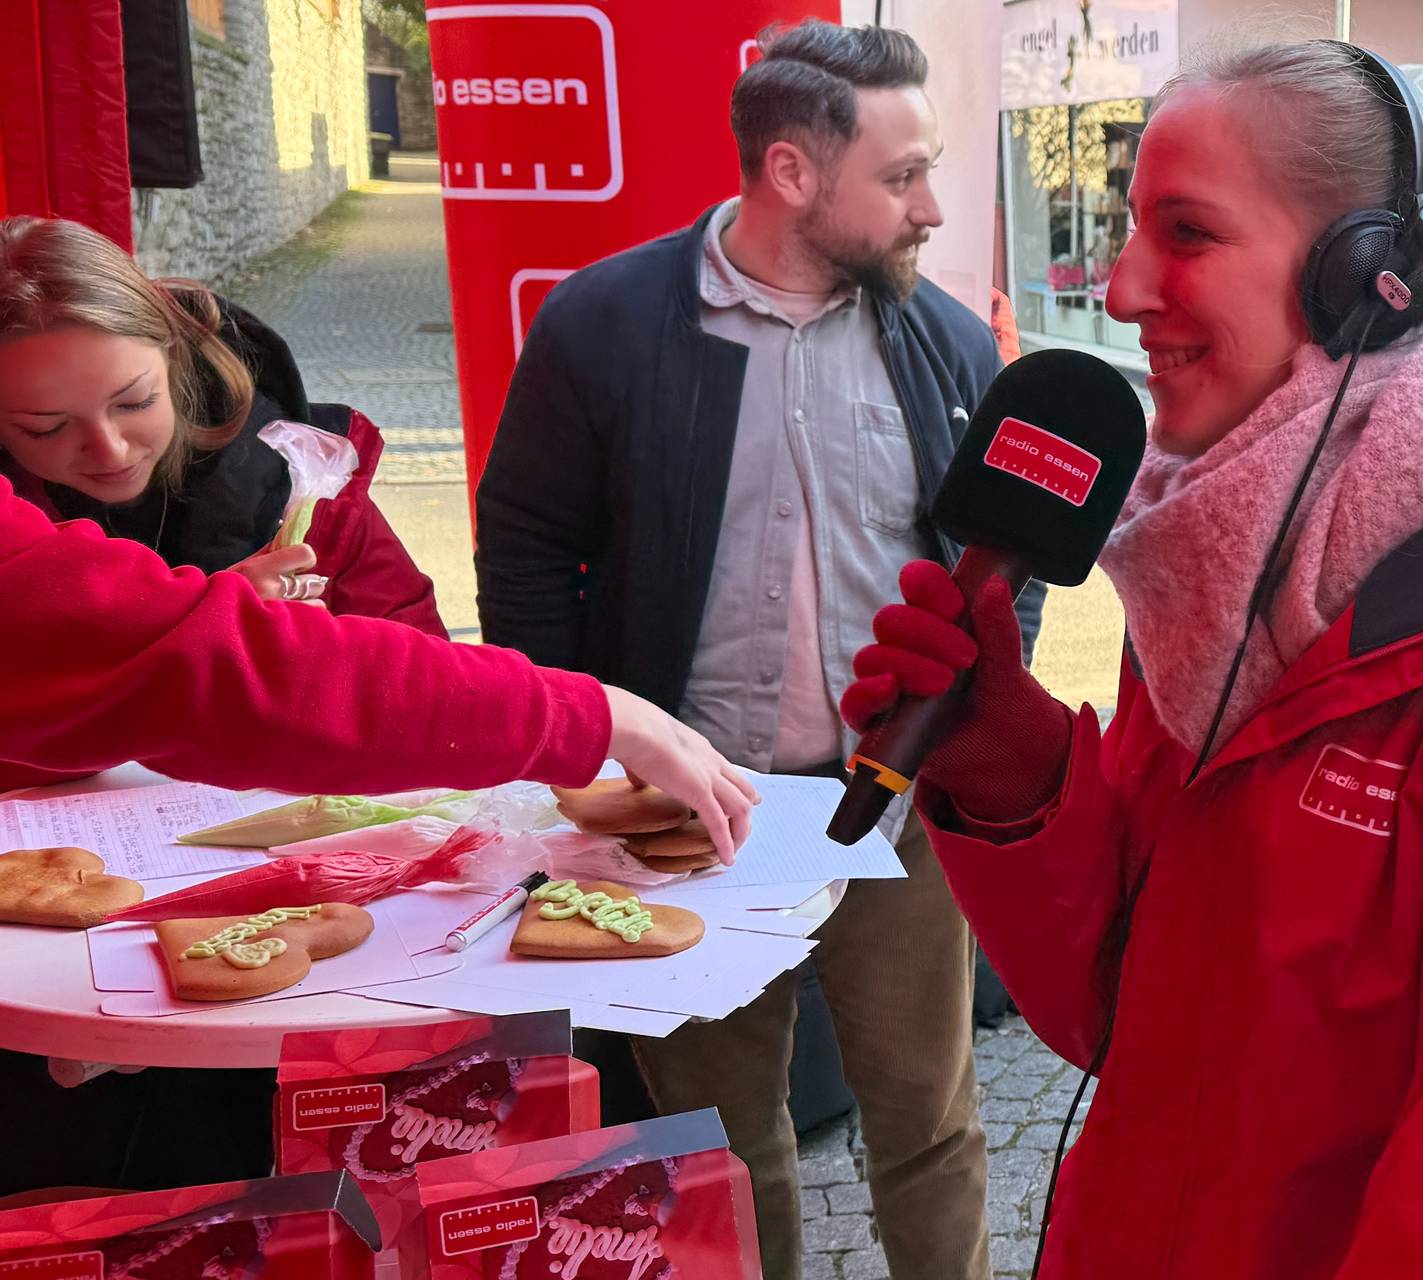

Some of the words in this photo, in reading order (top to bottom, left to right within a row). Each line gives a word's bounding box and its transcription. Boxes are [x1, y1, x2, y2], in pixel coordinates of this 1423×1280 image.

[452, 77, 588, 106] essen
[1000, 435, 1040, 456] radio
[1044, 453, 1089, 482] essen
[1318, 768, 1360, 791] radio
[299, 1106, 340, 1118] essen
[345, 1101, 379, 1114] radio
[495, 1216, 533, 1231] radio
[448, 1224, 491, 1241] essen
